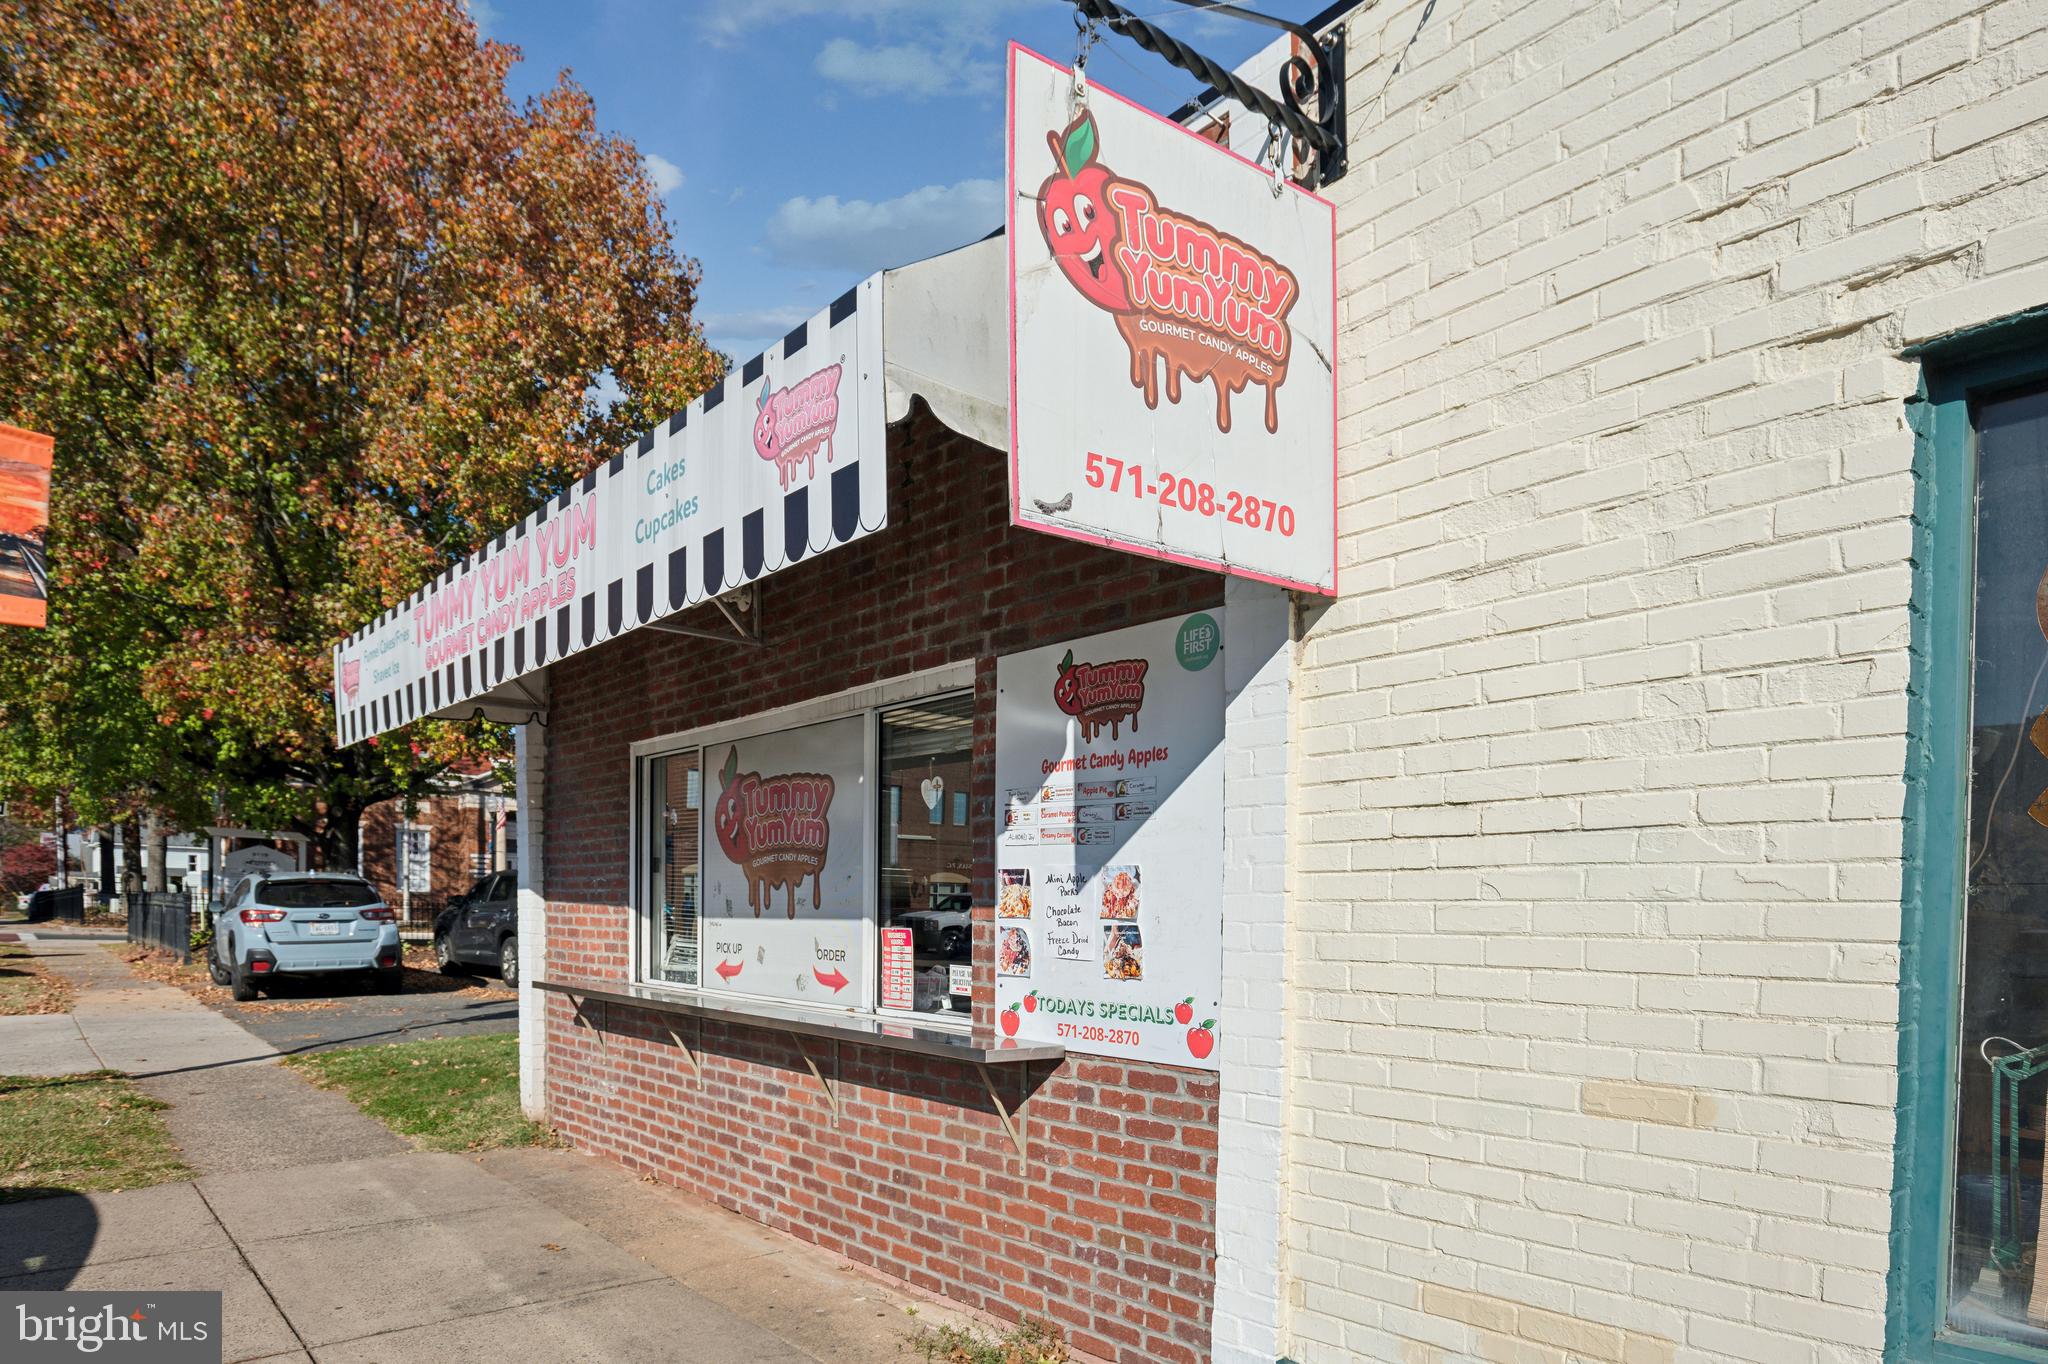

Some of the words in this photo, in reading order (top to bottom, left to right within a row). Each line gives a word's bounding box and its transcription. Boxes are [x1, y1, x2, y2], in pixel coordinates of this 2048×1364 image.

[1111, 189, 1291, 317] Tummy
[1119, 247, 1284, 356] YumYum
[1139, 319, 1196, 341] GOURMET
[1199, 333, 1235, 355] CANDY
[1235, 350, 1273, 376] APPLES
[773, 366, 839, 422] Tummy
[646, 458, 686, 495] Cakes
[1085, 452, 1295, 536] 571-208-2870
[635, 495, 699, 544] Cupcakes
[414, 570, 477, 648] TUMMY
[481, 536, 529, 610] YUM
[536, 492, 597, 578] YUM
[426, 623, 475, 671] GOURMET
[477, 597, 519, 646] CANDY
[521, 566, 577, 623] APPLES
[1183, 639, 1212, 655] FIRST
[1079, 662, 1144, 689] Tummy
[1080, 682, 1141, 707] YumYum
[1085, 706, 1106, 717] GOURMET
[1106, 703, 1120, 711] CANDY
[1041, 754, 1087, 774] Gourmet
[1089, 750, 1125, 771] Candy
[1127, 746, 1169, 769] Apples
[742, 779, 830, 821] Tummy
[744, 809, 826, 851] YumYum
[752, 853, 778, 868] GOURMET
[778, 853, 796, 861] CANDY
[797, 854, 819, 866] APPLES
[1045, 873, 1064, 884] Mini
[1066, 872, 1087, 886] Apple
[1046, 904, 1081, 918] Chocolate
[1056, 917, 1078, 927] Bacon
[716, 942, 731, 954] PICK
[732, 943, 743, 954] UP
[1047, 930, 1070, 945] Freeze
[816, 949, 846, 962] ORDER
[1057, 945, 1080, 958] Candy
[1037, 997, 1095, 1017] TODAYS
[1100, 1003, 1175, 1026] SPECIALS
[1056, 1023, 1140, 1046] 571-208-2870
